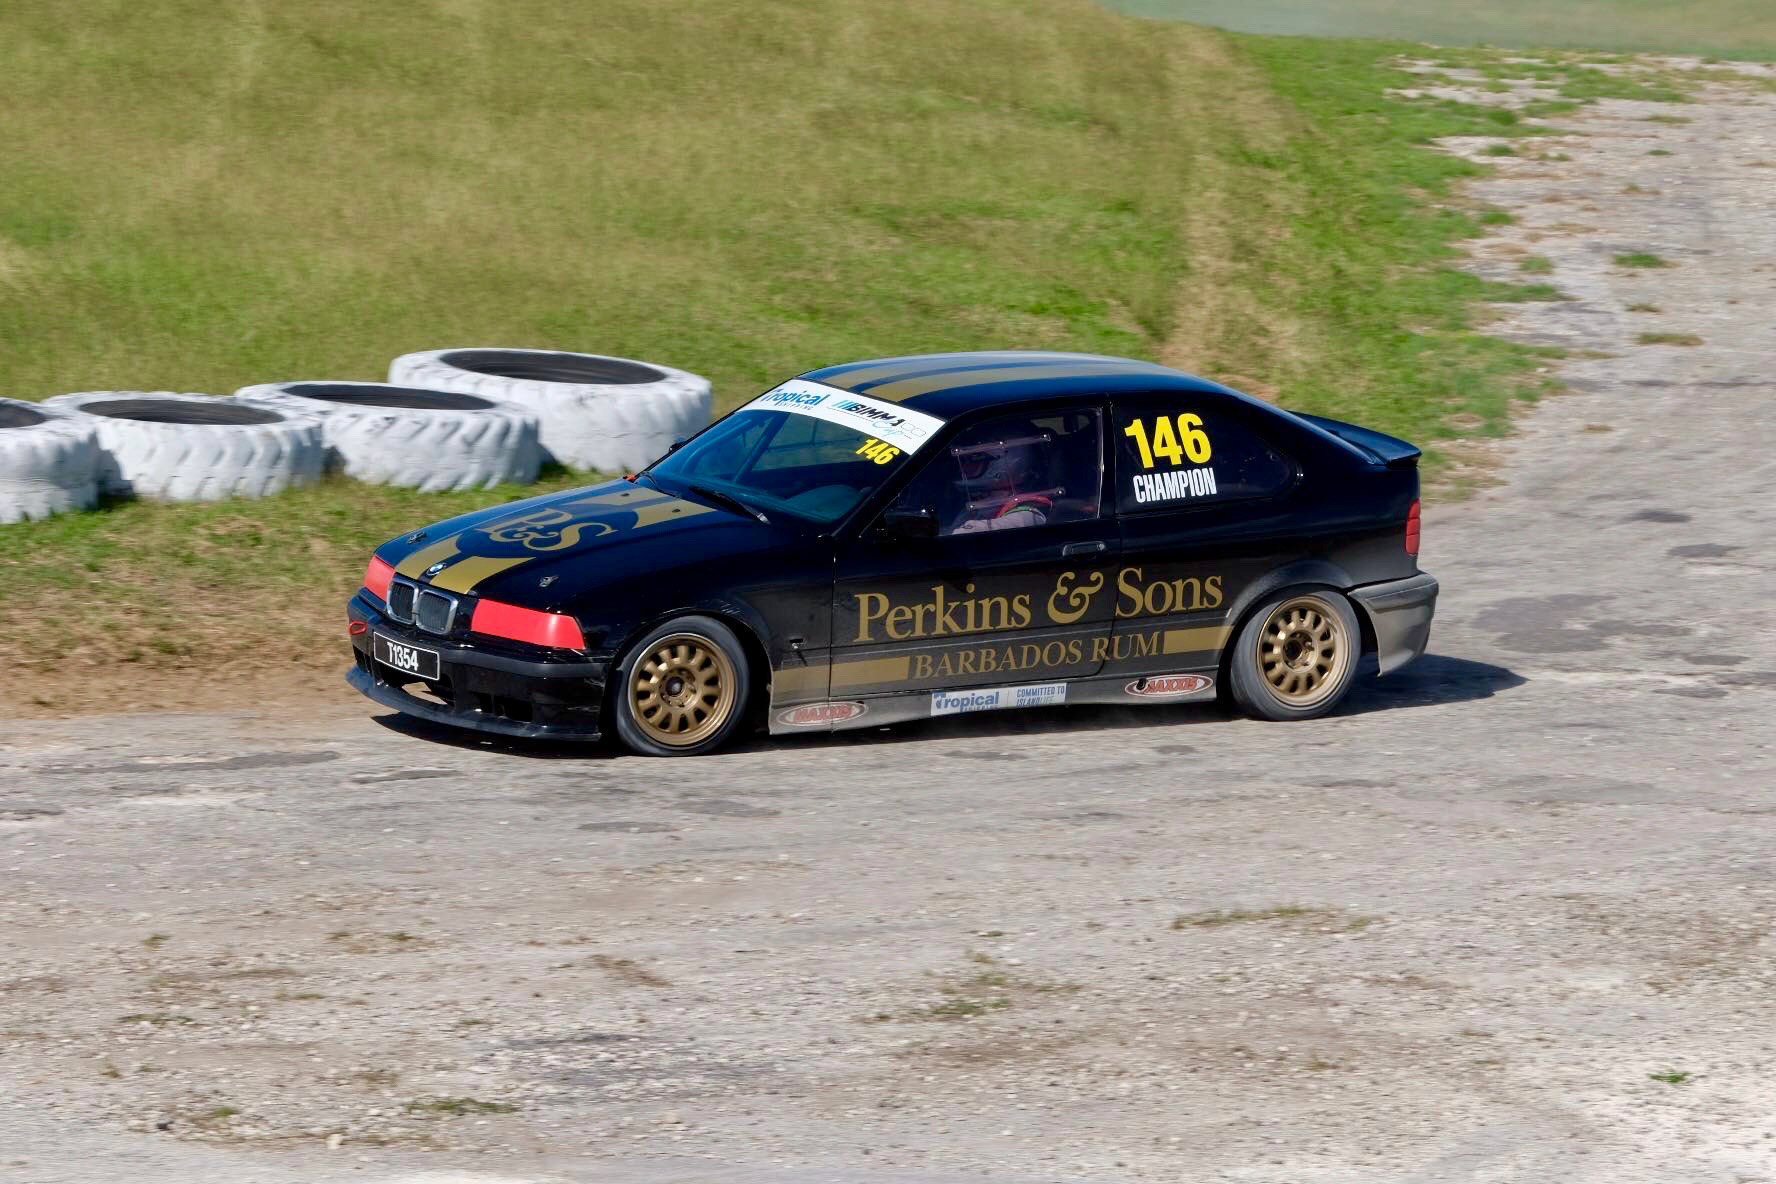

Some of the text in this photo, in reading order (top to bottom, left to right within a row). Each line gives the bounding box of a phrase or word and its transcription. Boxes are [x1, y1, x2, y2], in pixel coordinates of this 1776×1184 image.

[760, 388, 831, 406] Tropical
[856, 438, 900, 465] 146
[1124, 413, 1212, 469] 146
[1132, 467, 1217, 503] CHAMPION
[853, 567, 1223, 643] Perkins & Sons
[386, 641, 419, 671] T1354
[914, 630, 1160, 680] BARBADOS RUM
[933, 691, 1000, 710] Tropical
[1016, 685, 1066, 698] COMMITTED TO
